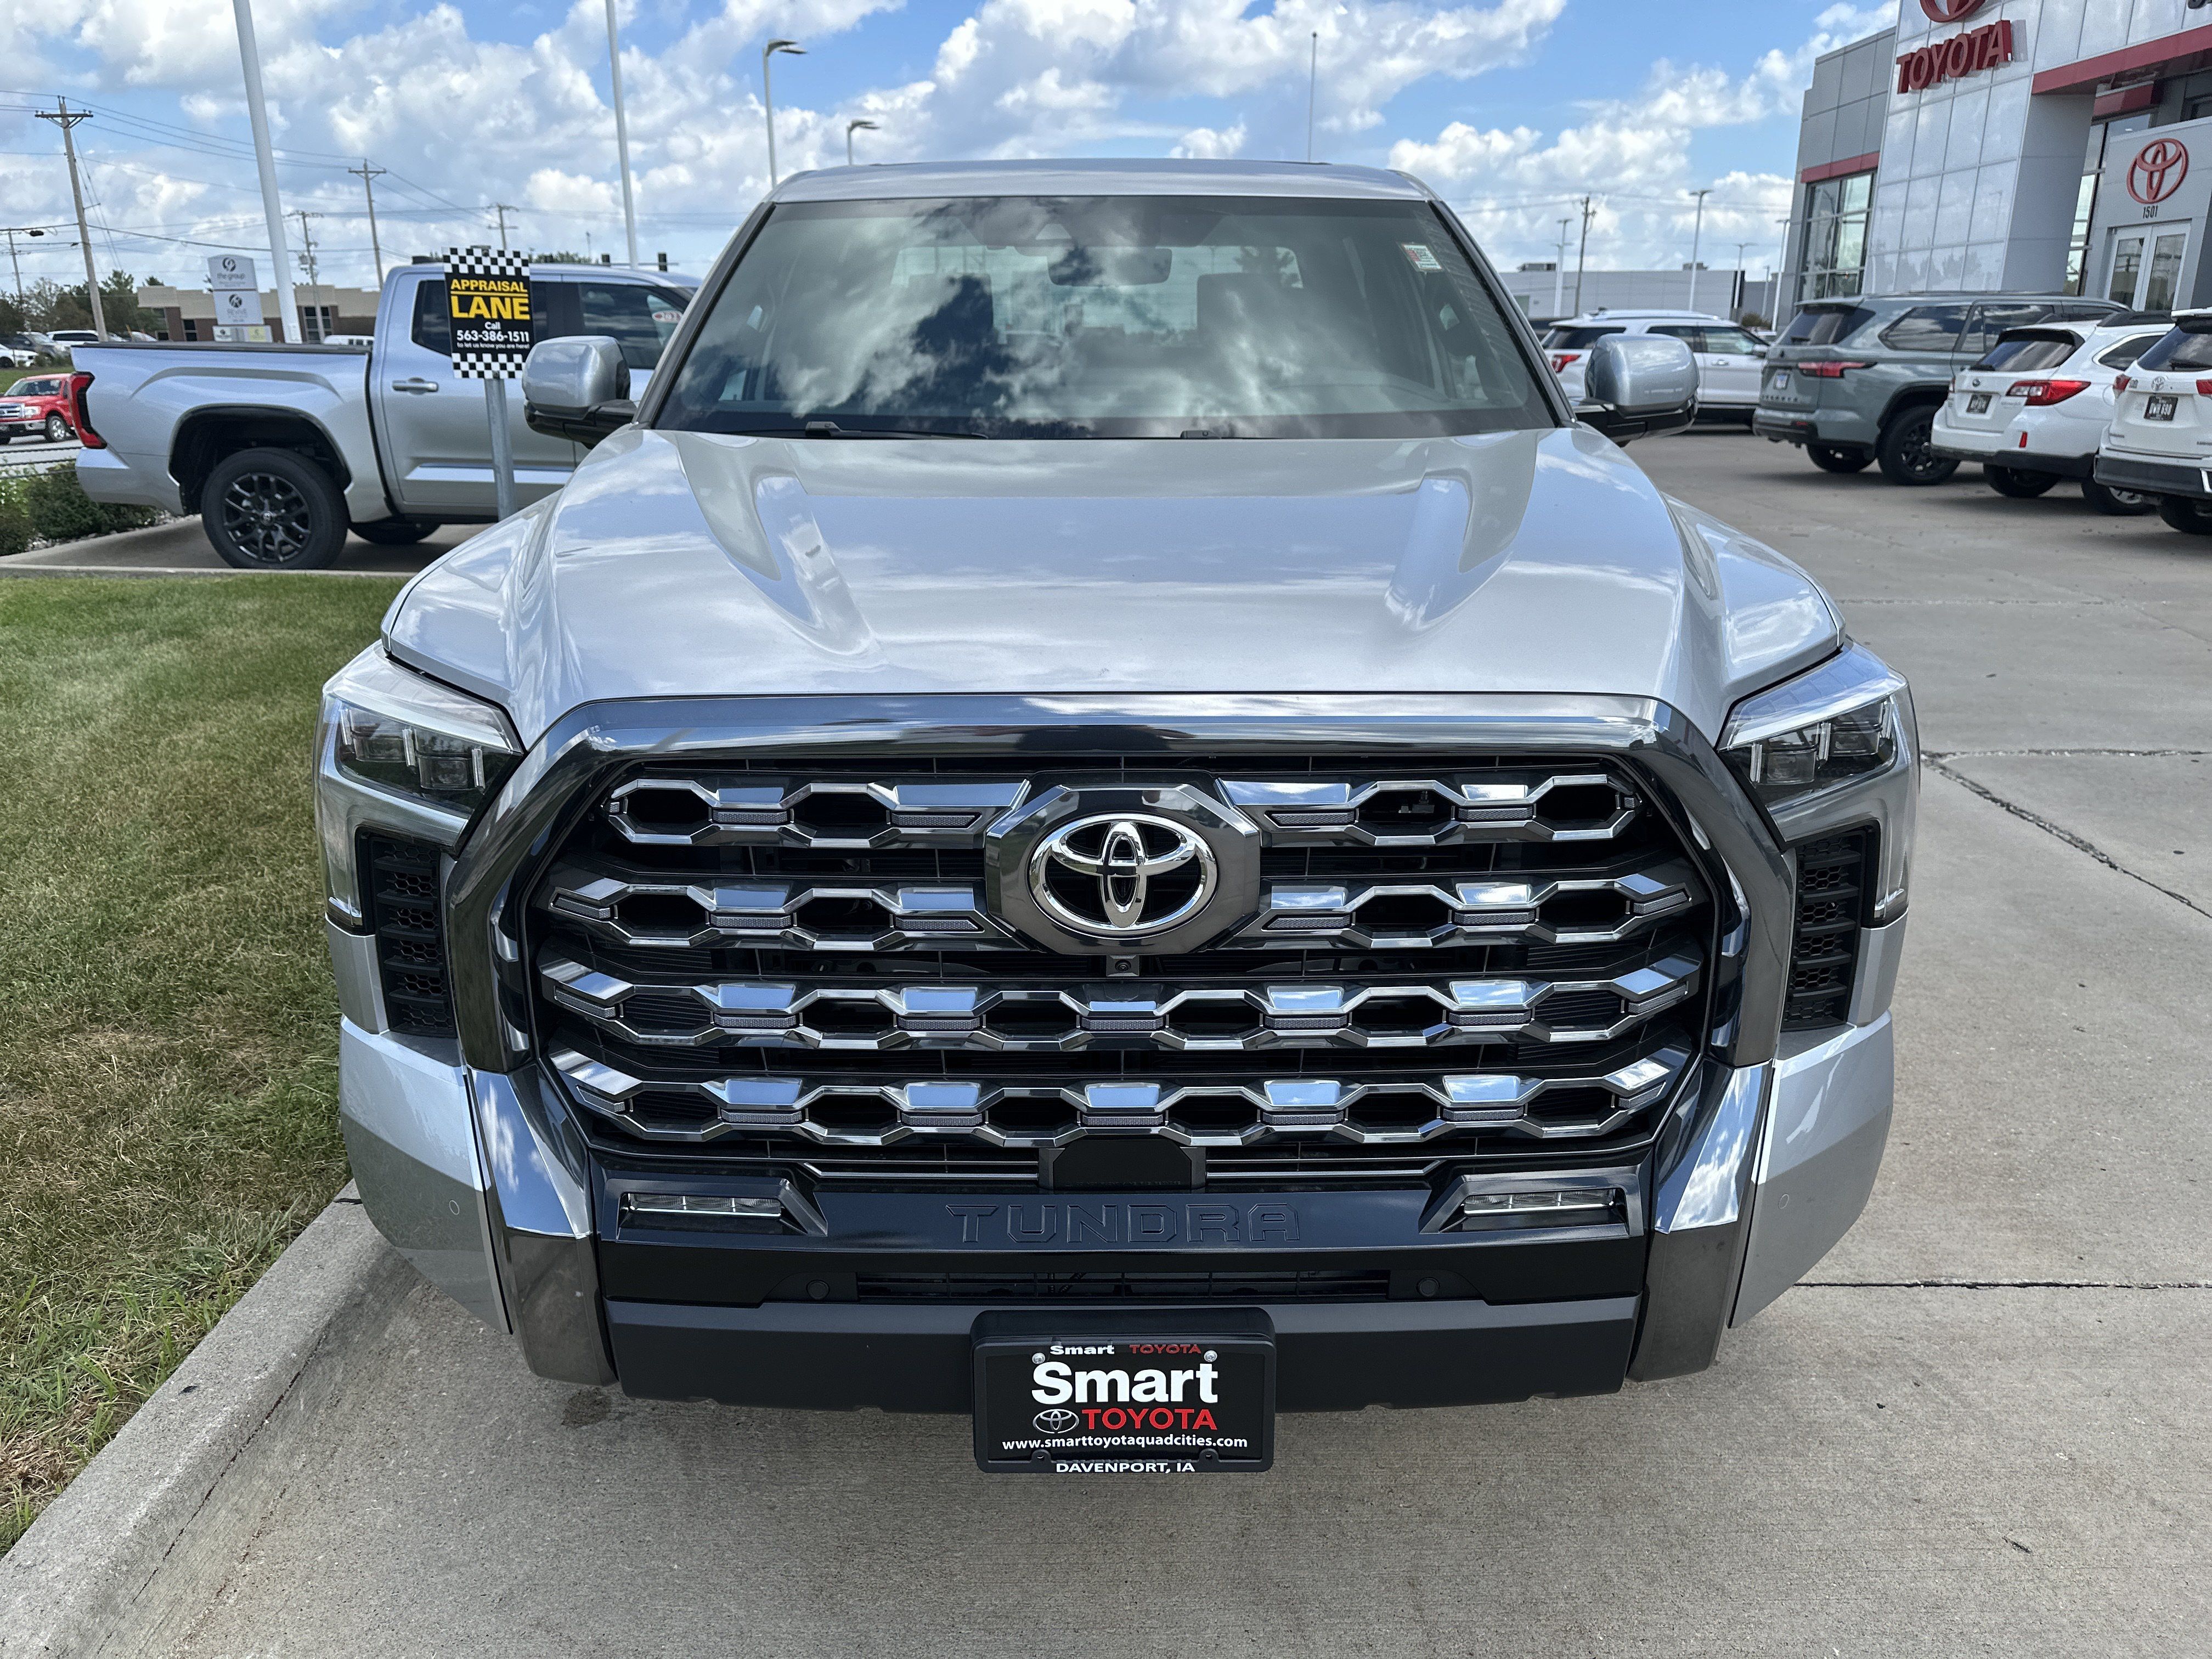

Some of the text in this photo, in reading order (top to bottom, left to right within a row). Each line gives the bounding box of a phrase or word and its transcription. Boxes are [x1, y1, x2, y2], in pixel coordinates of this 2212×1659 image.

[1896, 20, 2012, 94] TOYOTA
[2142, 205, 2158, 219] 1501
[450, 279, 528, 292] APPRAISAL
[450, 296, 531, 320] LANE
[484, 321, 501, 330] Call
[456, 330, 529, 342] 563-386-1511
[945, 1203, 1301, 1243] TUNDRA
[1050, 1344, 1201, 1355] Smart TOYOTA
[1031, 1361, 1218, 1405] Smart
[1081, 1408, 1217, 1430] TOYOTA
[1002, 1434, 1248, 1450] www.smarttoyotaquadcities.com
[1056, 1462, 1195, 1474] DAVENPORT, IA
